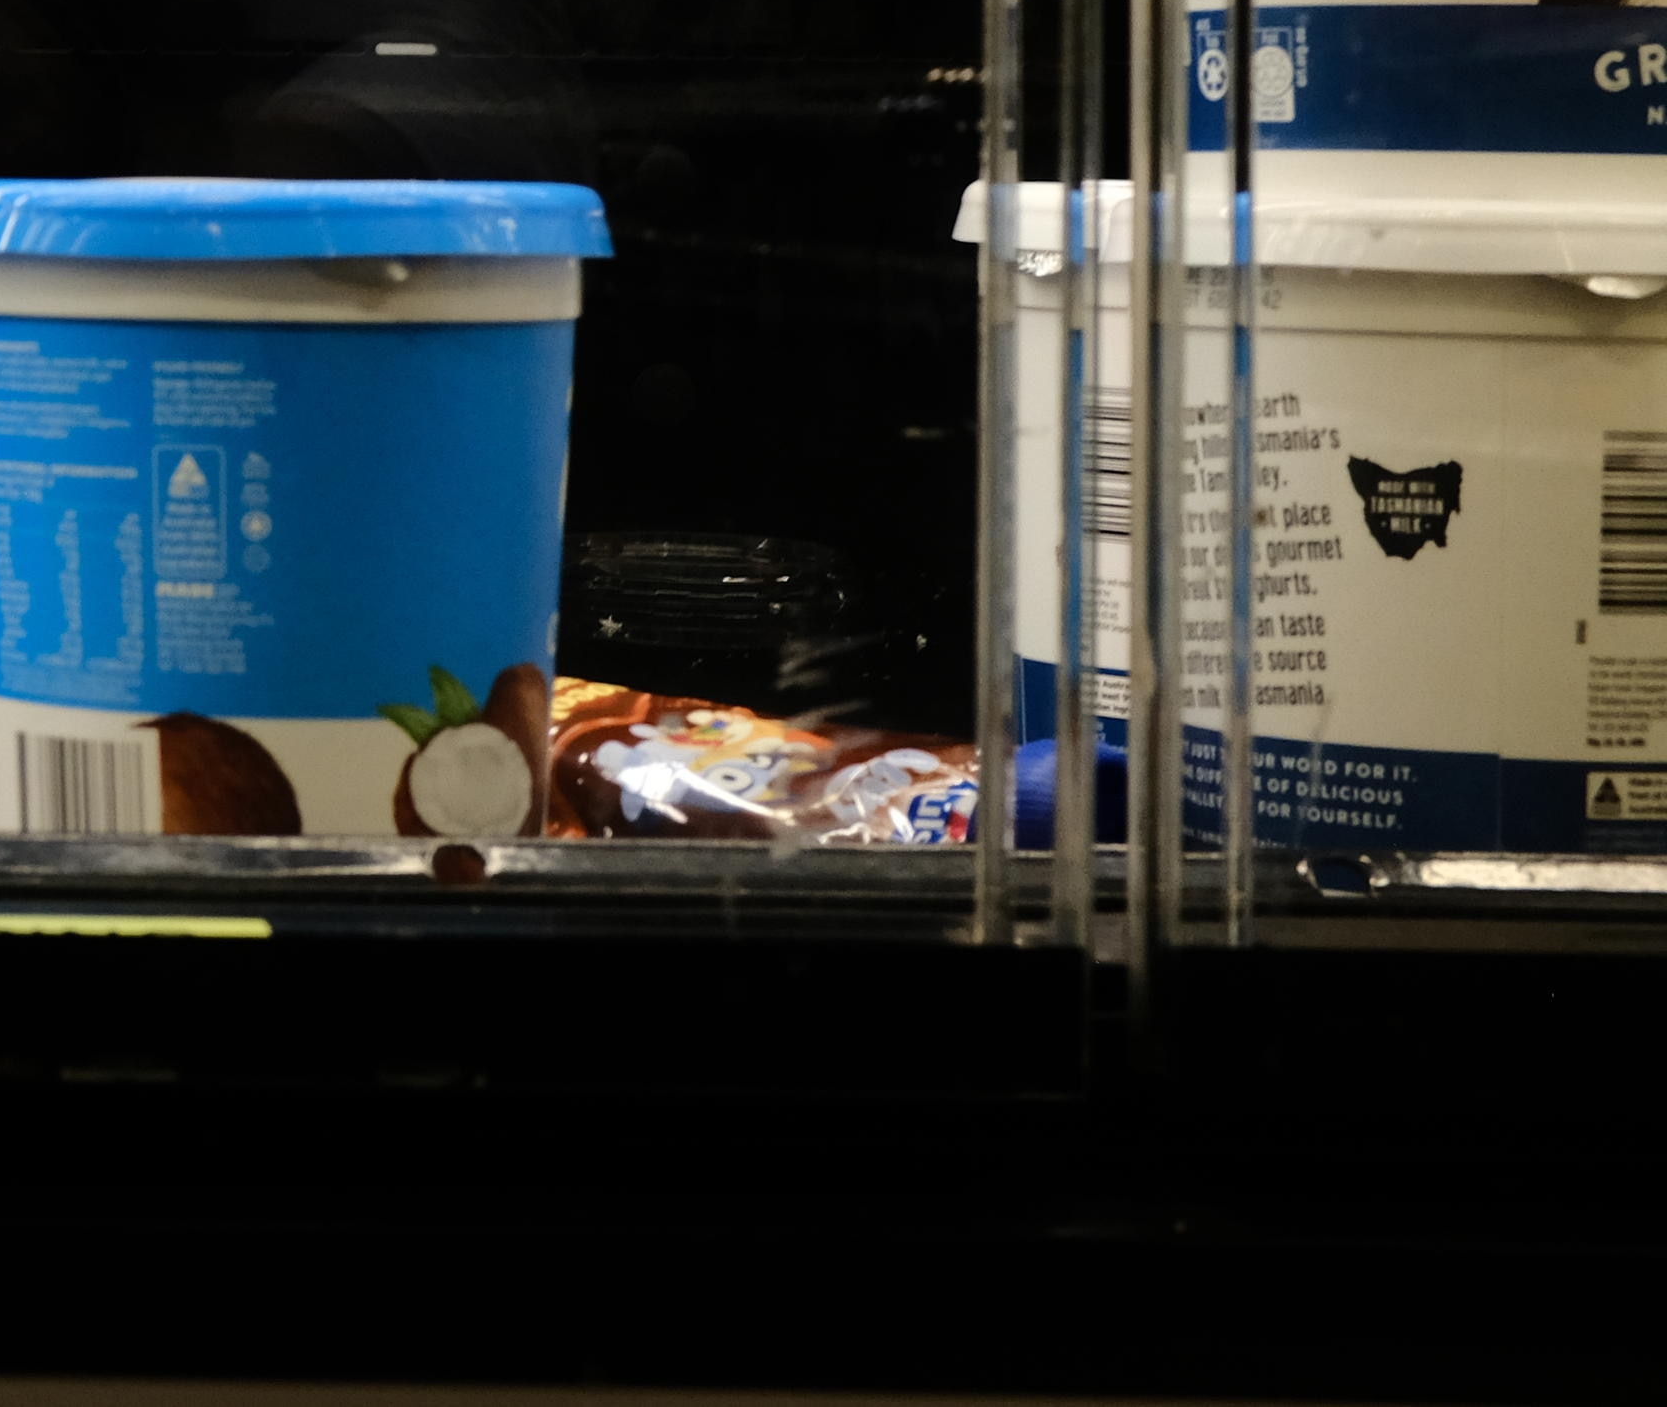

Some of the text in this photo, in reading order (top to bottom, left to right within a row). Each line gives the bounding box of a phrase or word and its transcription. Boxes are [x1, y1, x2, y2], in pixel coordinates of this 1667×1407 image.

[1282, 502, 1332, 530] place
[1370, 495, 1444, 515] TASMANIAN
[1390, 516, 1422, 534] MILK
[1267, 536, 1344, 567] gourmet
[1280, 612, 1326, 637] taste
[1268, 648, 1327, 672] source
[1344, 761, 1385, 778] FOR
[1393, 765, 1418, 783] IT.
[1267, 776, 1290, 794] OF
[1257, 799, 1291, 819] FOR
[1297, 803, 1403, 831] YOURSELF.
